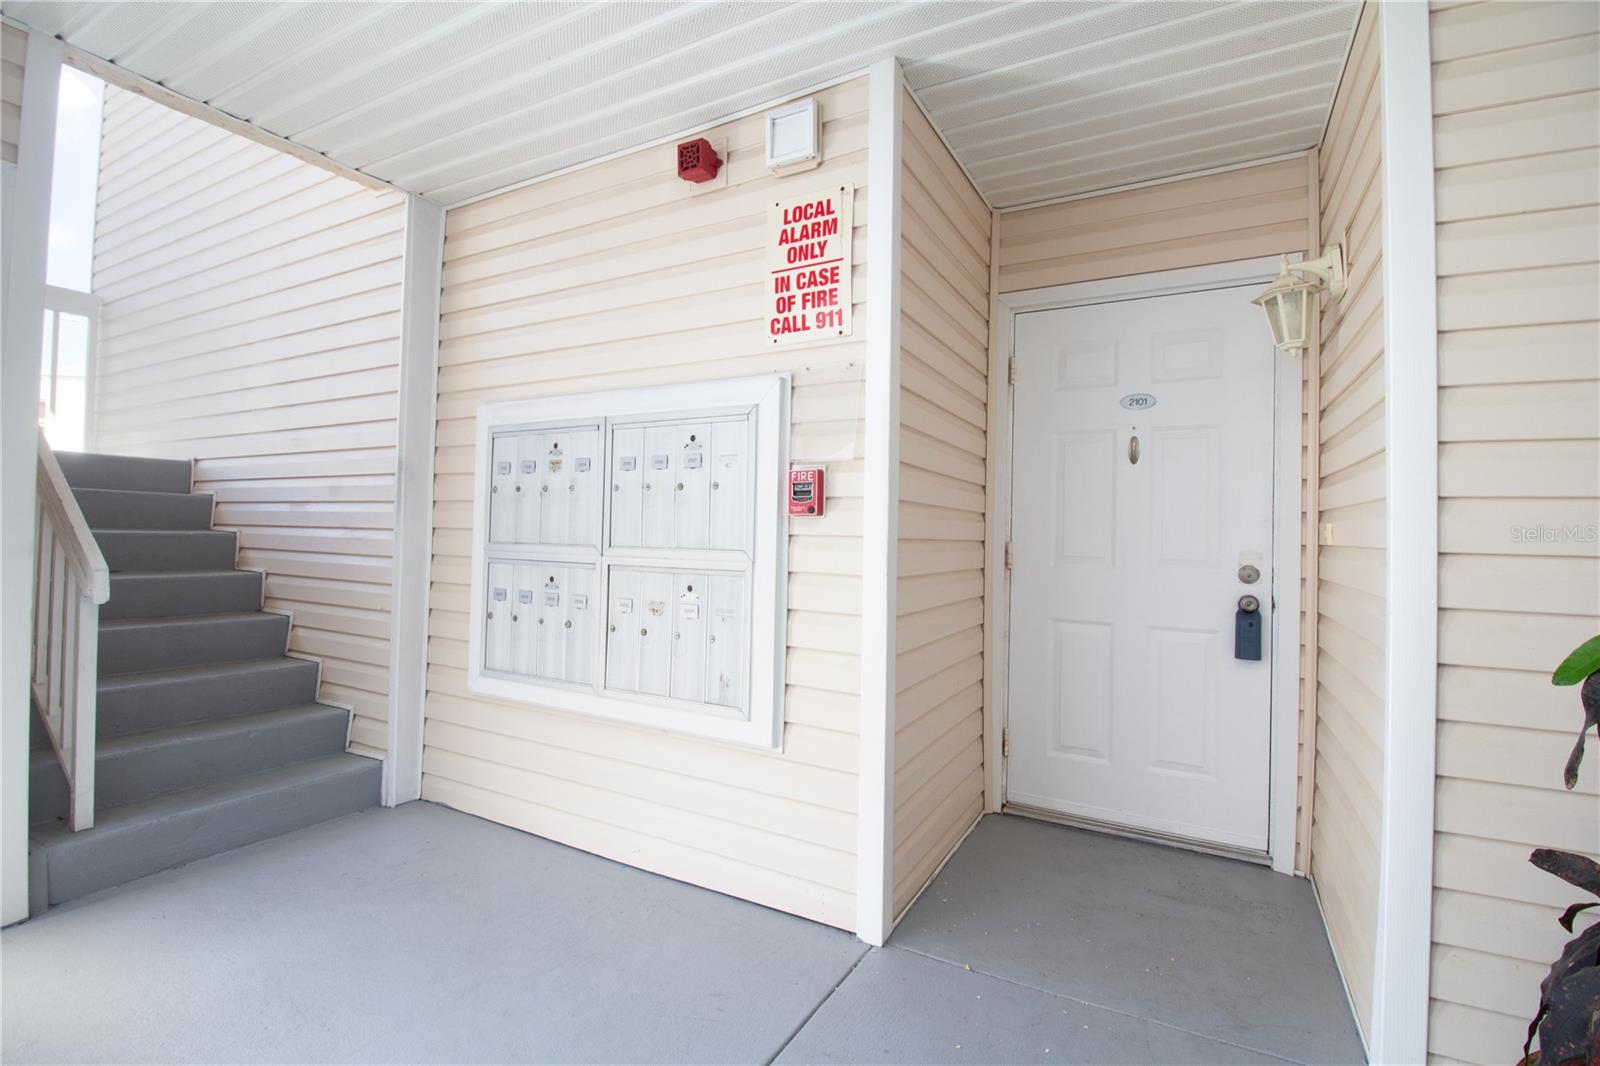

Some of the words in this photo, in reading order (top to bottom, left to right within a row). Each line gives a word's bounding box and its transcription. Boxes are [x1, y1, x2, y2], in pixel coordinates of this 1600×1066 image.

[783, 198, 836, 226] LOCAL
[778, 217, 838, 246] ALARM
[786, 240, 828, 265] ONLY
[774, 275, 791, 294] IN
[796, 266, 840, 290] CASE
[776, 295, 796, 315] OF
[801, 288, 839, 311] FIRE
[770, 316, 811, 336] CALL
[815, 308, 844, 329] 911
[1128, 398, 1148, 407] 2101
[791, 471, 814, 481] FIRE
